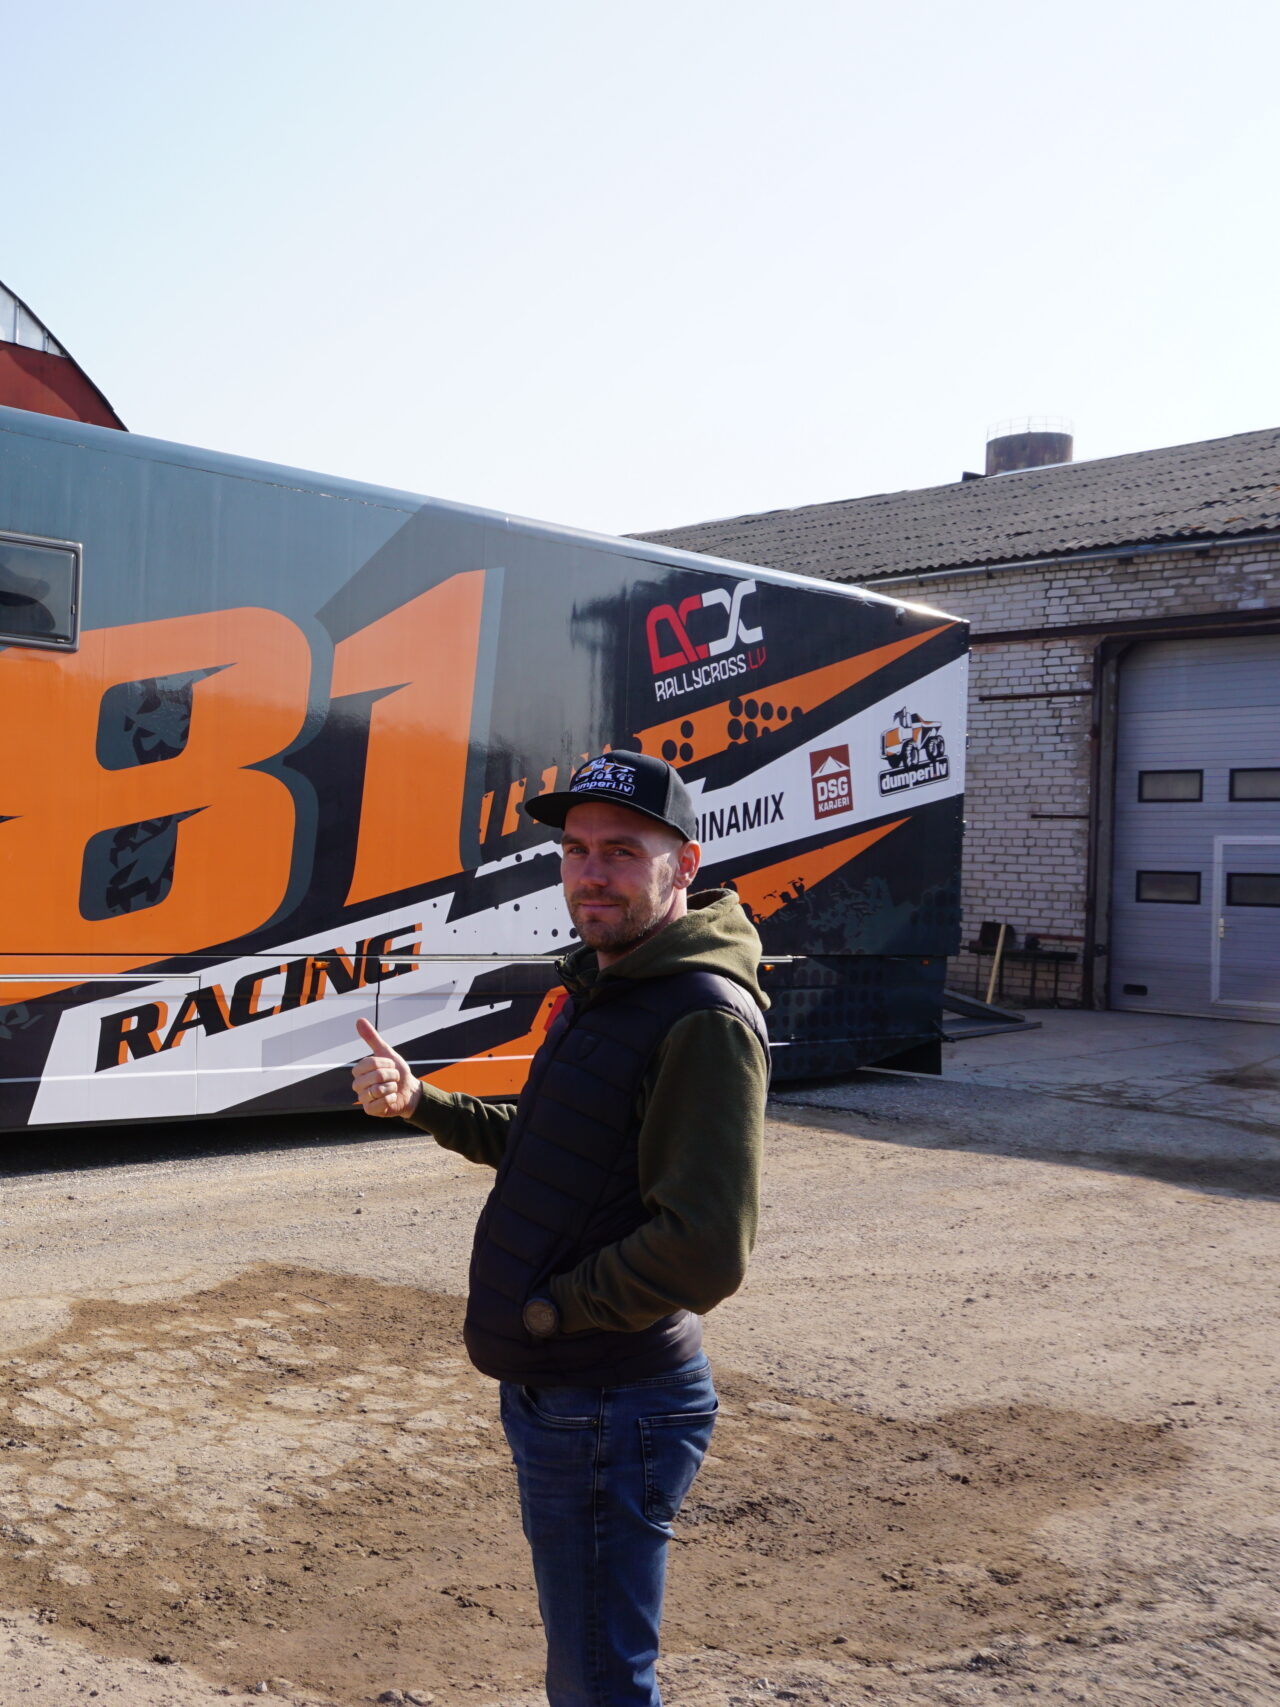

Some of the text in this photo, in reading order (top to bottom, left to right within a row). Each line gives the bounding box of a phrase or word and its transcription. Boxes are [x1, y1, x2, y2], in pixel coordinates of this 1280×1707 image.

[654, 646, 767, 702] RALLYCROSS.LV
[816, 776, 849, 802] DSG
[880, 761, 948, 792] dumperi.lv
[818, 796, 850, 813] KARJERI
[94, 922, 423, 1073] RACING
